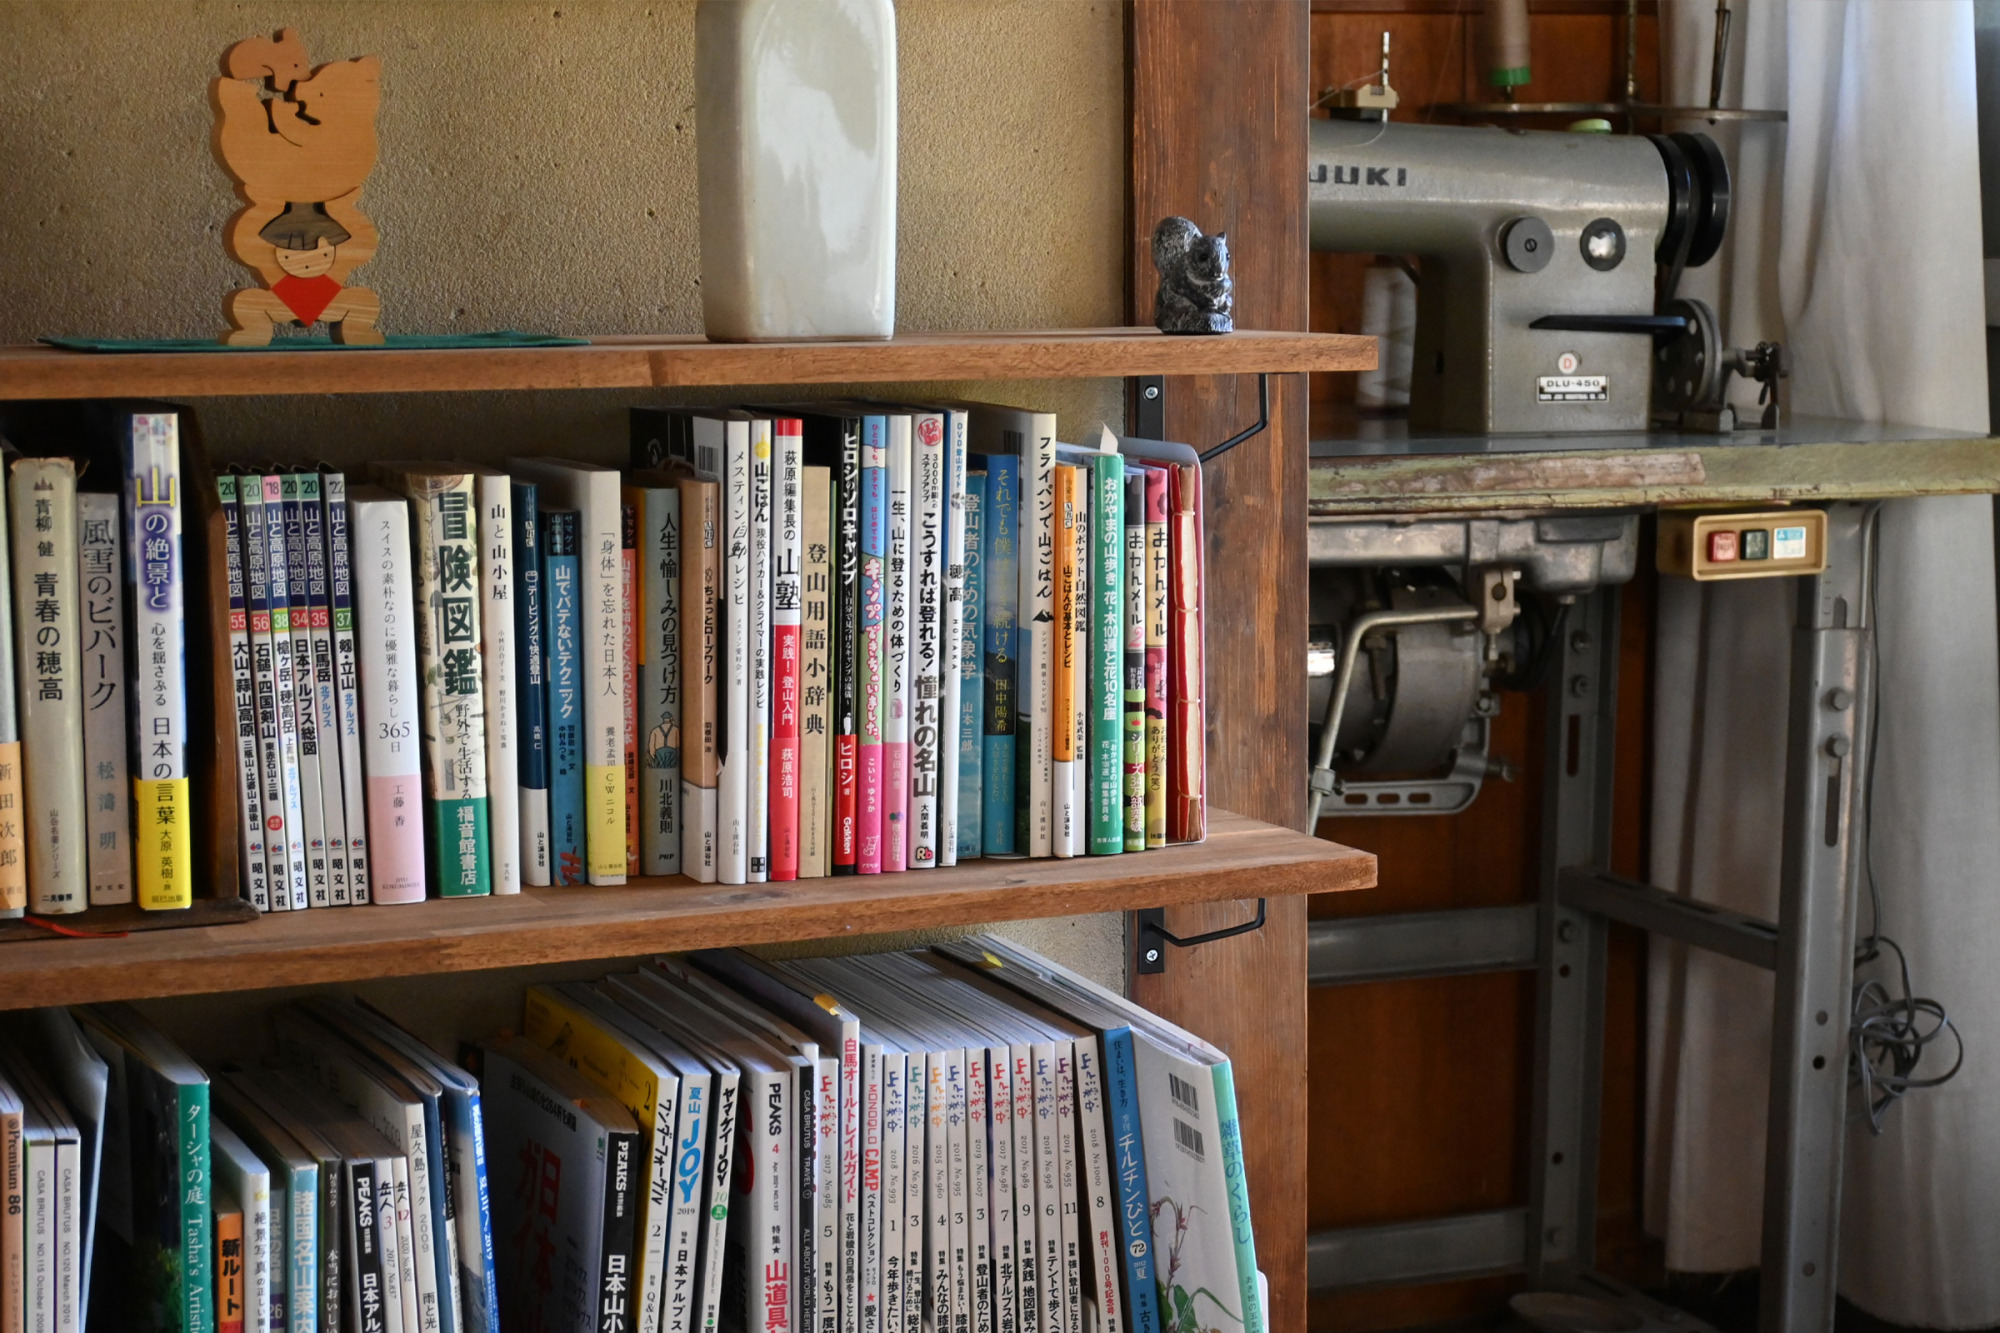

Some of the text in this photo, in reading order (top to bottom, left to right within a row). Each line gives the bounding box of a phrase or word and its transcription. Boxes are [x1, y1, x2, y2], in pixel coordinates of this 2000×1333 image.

[1309, 164, 1406, 187] JUKI
[1546, 379, 1600, 388] DLU-450
[1563, 357, 1572, 369] D
[754, 462, 769, 523] 山ごはん
[843, 433, 858, 586] ヒロシのソロキャンプ
[922, 453, 930, 503] ステップアップ
[35, 499, 53, 532] 青柳
[728, 451, 748, 606] メスティン自動レシピ
[775, 450, 801, 611] 萩原編集長の 山塾
[1036, 436, 1053, 599] フライパンで山ごはん
[1104, 477, 1118, 585] おかやまの山歩き
[246, 511, 266, 600] 山と高原地図
[267, 508, 287, 597] 山と高原地図
[491, 504, 508, 601] 山と山小屋
[1076, 511, 1086, 632] 山のポケット自然図鑑
[1129, 531, 1145, 626] おかんメール
[1153, 527, 1168, 637] おかんメール
[82, 518, 117, 711] 風雪のビバーク
[253, 617, 269, 631] 56
[274, 613, 289, 627] 38
[438, 491, 478, 695] 冒険図鑑
[600, 532, 618, 696] 「身体」を忘れた日本人
[660, 512, 678, 705] 人生・愉しみの見つけ方
[890, 490, 906, 693] 一生、山に登るための体づくり
[949, 563, 963, 670] 穂高 HOTAKA
[960, 494, 981, 751] 登山者のための気象学 山本三郎
[1063, 565, 1073, 668] 山ごはんの基本とレシピ
[34, 572, 63, 701] 青春の穂高
[135, 466, 176, 852] 山の絶景と 心を揺さぶる 日本の言葉 大原
[527, 586, 541, 686] テーピングで快適登山
[555, 565, 574, 719] 山でバテないテクニック
[704, 586, 713, 685] ちょっとロープワーク
[805, 543, 827, 736] 登山用語小辞典
[1128, 626, 1144, 648] 2
[226, 509, 266, 905] 山と高原地図 55 大山・蒜山高原 昭文社
[284, 507, 326, 902] 山と高原地図 34 日本アルプス総図 昭文社
[304, 508, 345, 901] 山と高原地図 35 白馬岳 北アルプス 昭文社
[332, 508, 366, 901] 山と高原地図 37 北アルプス 昭文社
[913, 675, 938, 798] 憧れの名山
[994, 678, 1008, 731] 田中陽希
[287, 767, 298, 810] 北アルプス
[455, 704, 478, 886] 野外で生活する 福音館書店
[781, 747, 793, 799] 萩原浩司
[841, 743, 853, 786] ヒロシ
[867, 758, 876, 812] こいし ゆうか
[393, 785, 405, 827] 工藤 香
[659, 779, 672, 833] 川北義則
[843, 816, 851, 855] Gakken
[273, 864, 286, 907] 昭文社
[293, 861, 304, 904] 昭文社
[658, 853, 674, 861] PHP
[768, 1082, 782, 1154] PEAKS 4
[803, 1089, 811, 1189] CASA BRUTUS TRAVEL
[844, 1038, 858, 1203] 白馬オールトレイルガイド
[867, 1083, 878, 1145] MONOQLO
[37, 1170, 45, 1195] CASA
[63, 1168, 71, 1193] CASA
[185, 1103, 206, 1205] ターシャの庭
[410, 1123, 427, 1206] 屋久島ブック
[615, 1140, 629, 1192] PEAKS
[651, 1099, 672, 1206] ワンダーフォーゲル
[676, 1086, 703, 1216] 夏山 JOY 2019
[864, 1148, 879, 1191] CAMP
[1218, 1118, 1251, 1245] 雑草のくらし
[8, 1194, 21, 1216] 86
[36, 1197, 45, 1236] BRUTUS
[63, 1196, 71, 1235] BRUTUS
[357, 1176, 373, 1228] PEAKS
[376, 1180, 394, 1230] 岳人 3
[395, 1180, 410, 1221] 岳人 12
[651, 1224, 662, 1238] 2
[771, 1224, 781, 1245] 特集
[823, 1225, 833, 1238] 5
[866, 1192, 876, 1264] ベストコレクション
[889, 1219, 896, 1232] 1
[910, 1215, 920, 1227] 3
[936, 1214, 947, 1226] 4
[954, 1212, 964, 1225] 3
[1000, 1209, 1009, 1222] 7
[1045, 1203, 1055, 1216] 6
[1064, 1202, 1077, 1215] 11
[1096, 1195, 1105, 1209] 8
[1118, 1132, 1148, 1280] チルチンびと 72 夏
[188, 1217, 204, 1277] Tasha's
[222, 1238, 240, 1316] 新ルート
[254, 1211, 267, 1275] 絶景写真
[293, 1190, 315, 1333] 諸国名山案内
[803, 1228, 811, 1306] ALL ABOUT WORLD
[976, 1208, 990, 1333] 3 登山者のため
[1022, 1203, 1036, 1332] 9 実践 地図読み
[1099, 1229, 1115, 1316] 創刊1000号記念号
[422, 1292, 437, 1330] 雨と光
[671, 1249, 688, 1332] 日本アルプス
